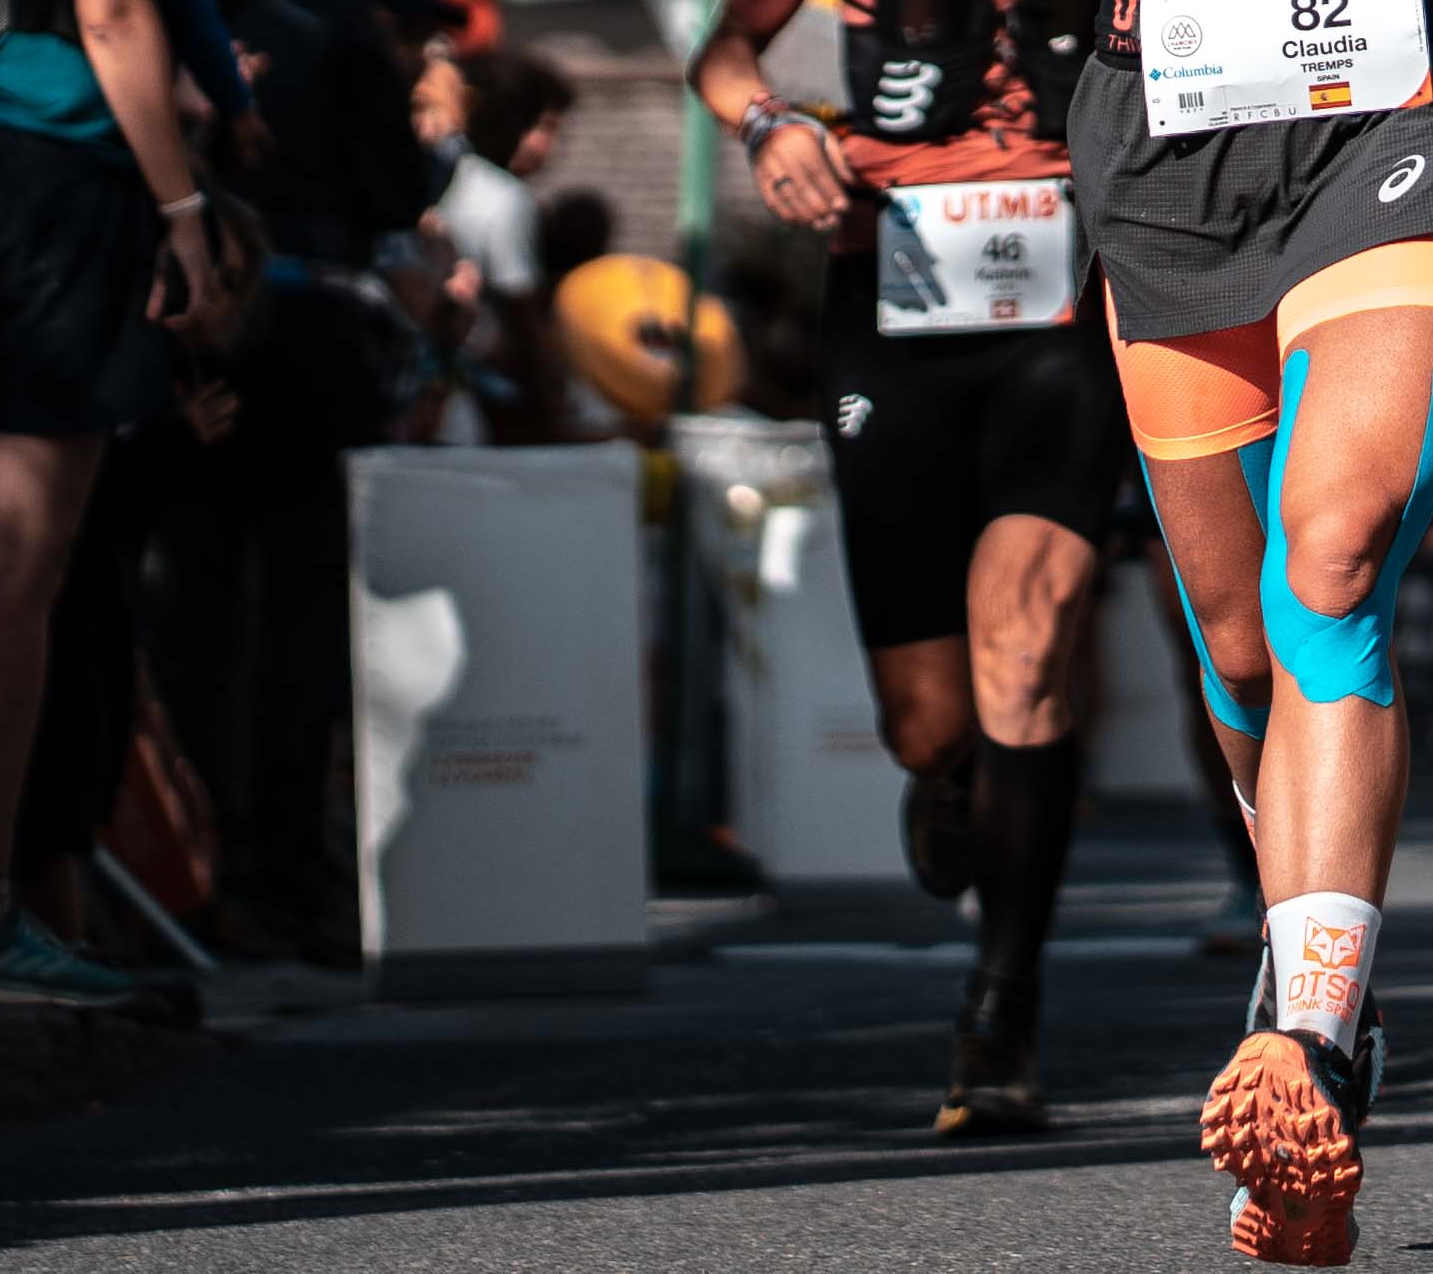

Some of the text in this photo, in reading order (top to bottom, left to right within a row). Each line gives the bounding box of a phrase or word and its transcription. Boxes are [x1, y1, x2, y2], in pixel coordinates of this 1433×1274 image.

[1282, 35, 1368, 58] Claudia
[1162, 64, 1223, 79] Columbia
[1301, 59, 1354, 73] TREMPS
[1317, 73, 1340, 82] SPAIN
[1260, 110, 1268, 118] C
[1274, 109, 1280, 117] B
[1289, 107, 1296, 115] U
[944, 188, 1058, 222] UTMB
[982, 233, 1027, 262] 46
[1288, 971, 1360, 1011] OTSO
